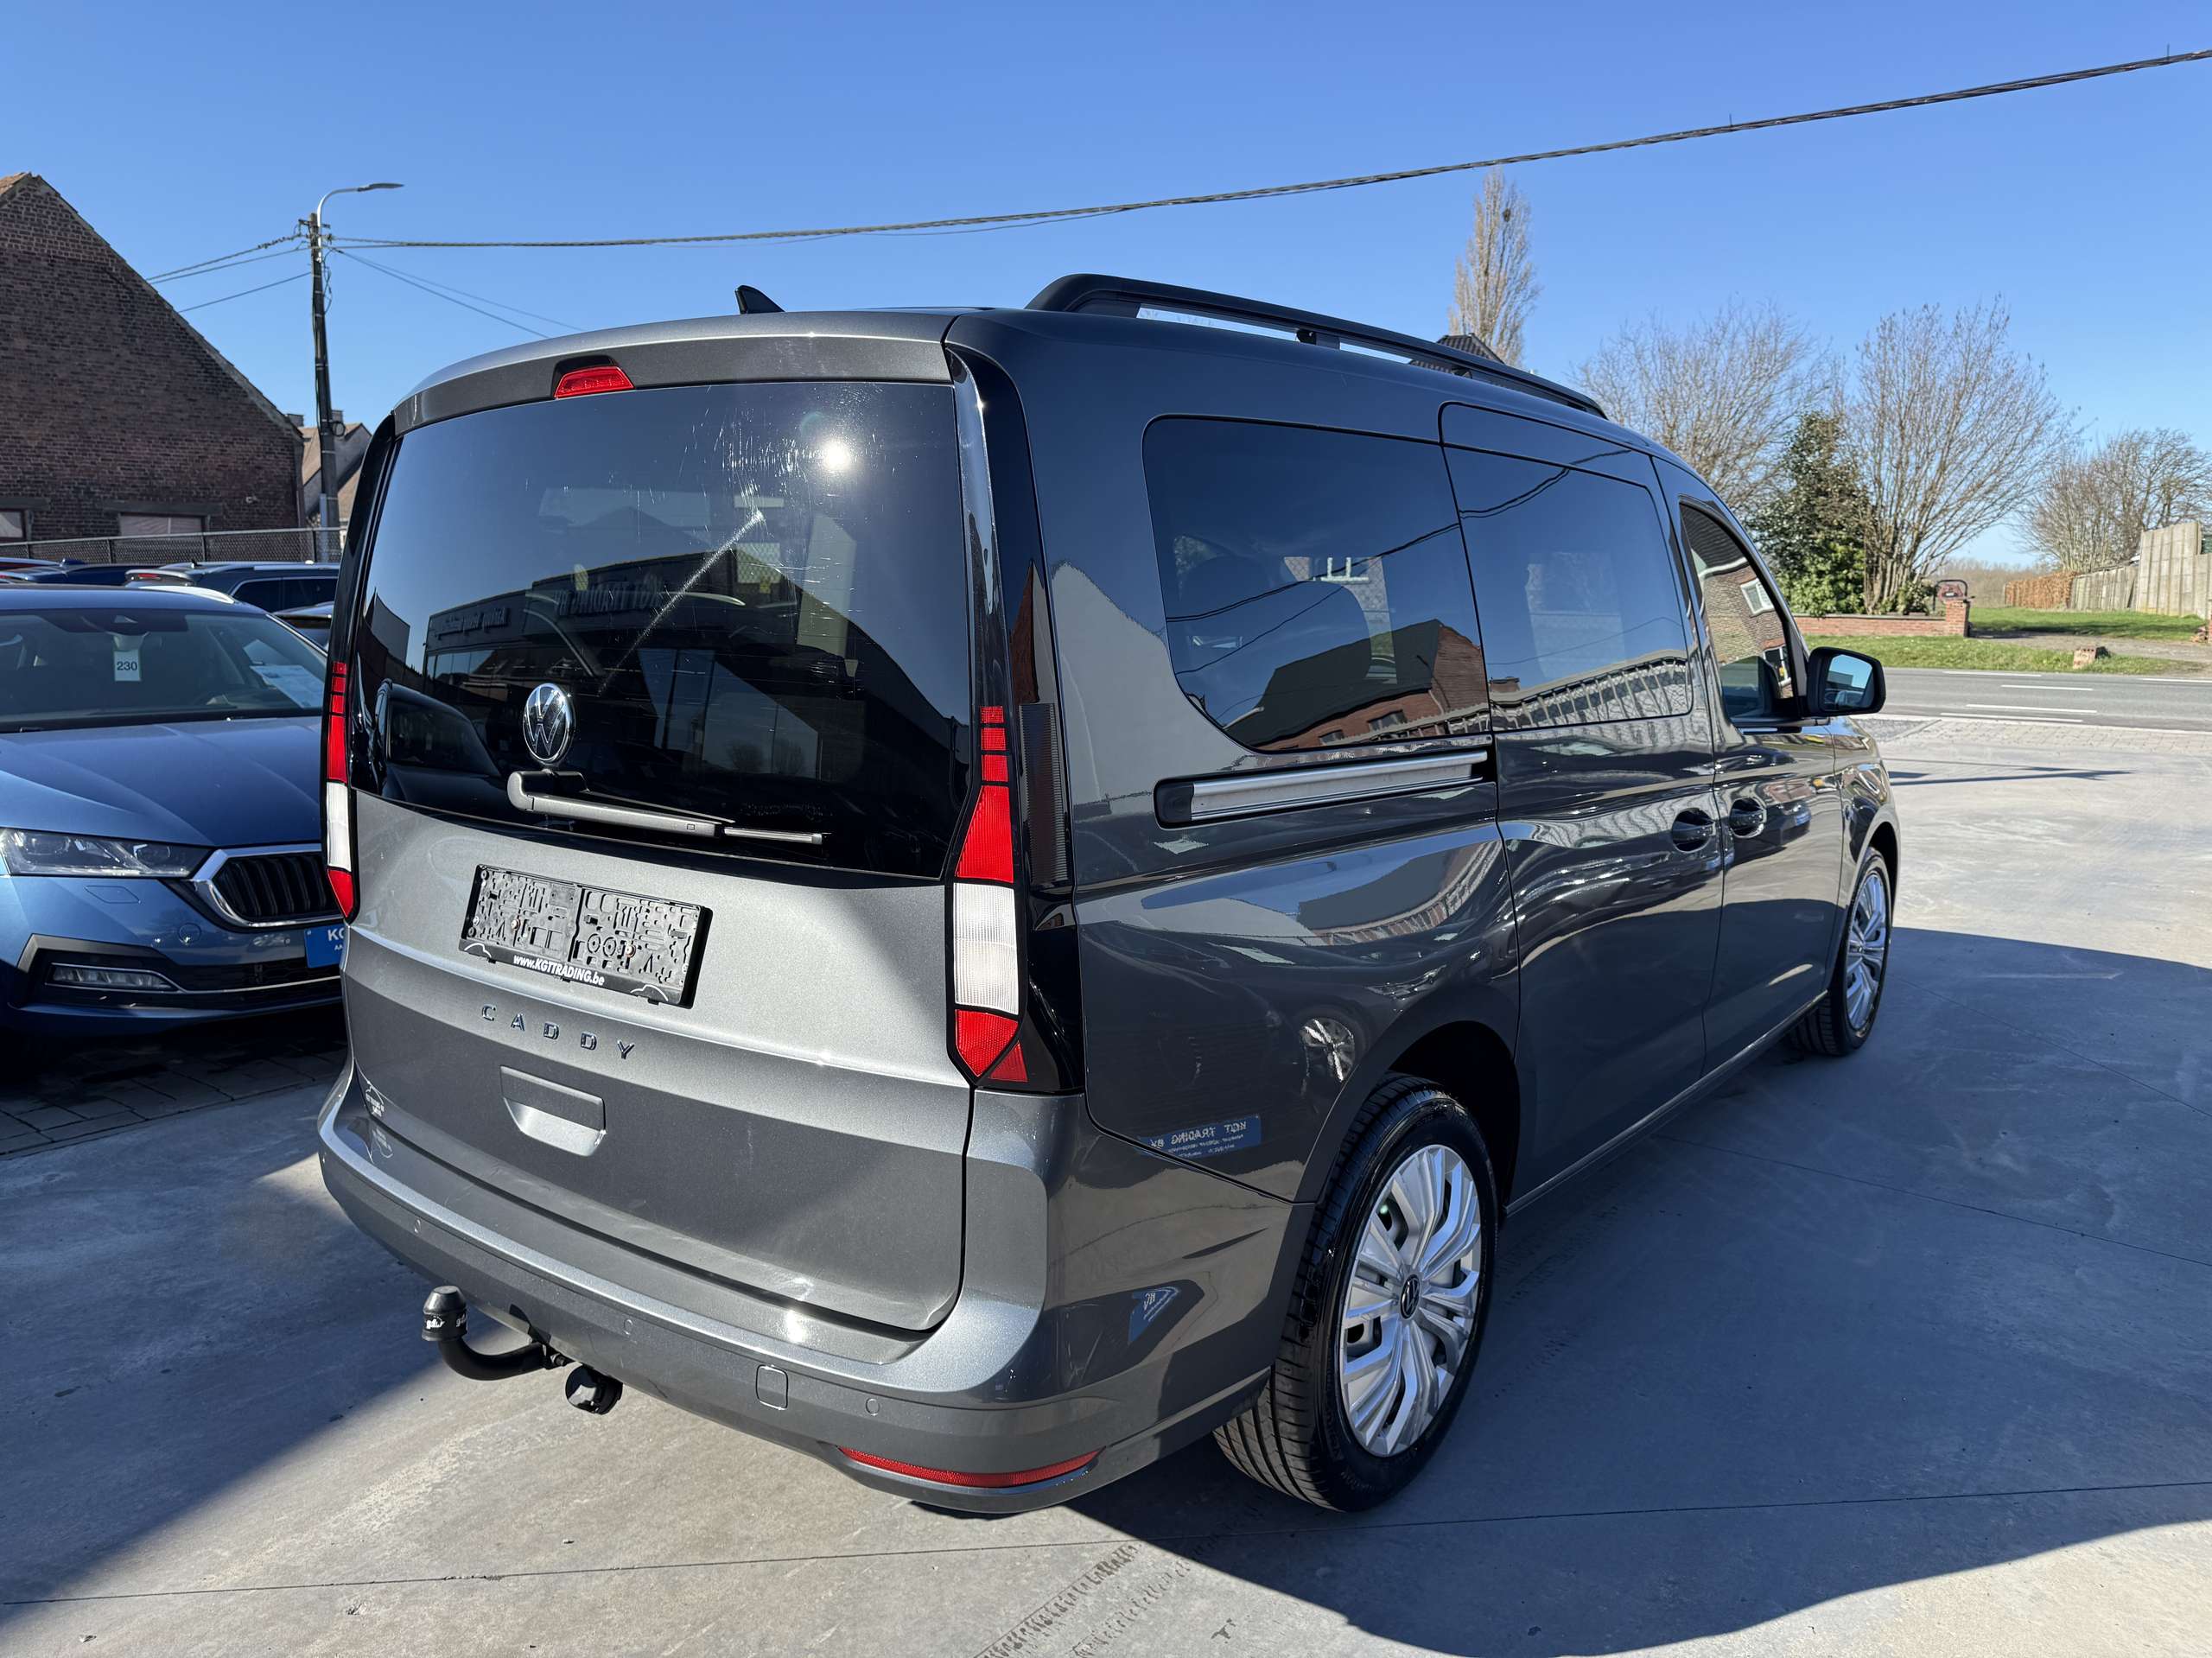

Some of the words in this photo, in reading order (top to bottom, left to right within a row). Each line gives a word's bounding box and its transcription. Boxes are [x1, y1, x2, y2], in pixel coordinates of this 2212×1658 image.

[116, 661, 138, 671] 230
[512, 954, 606, 987] www.KGTTRADING.be
[480, 1003, 636, 1060] CADDY
